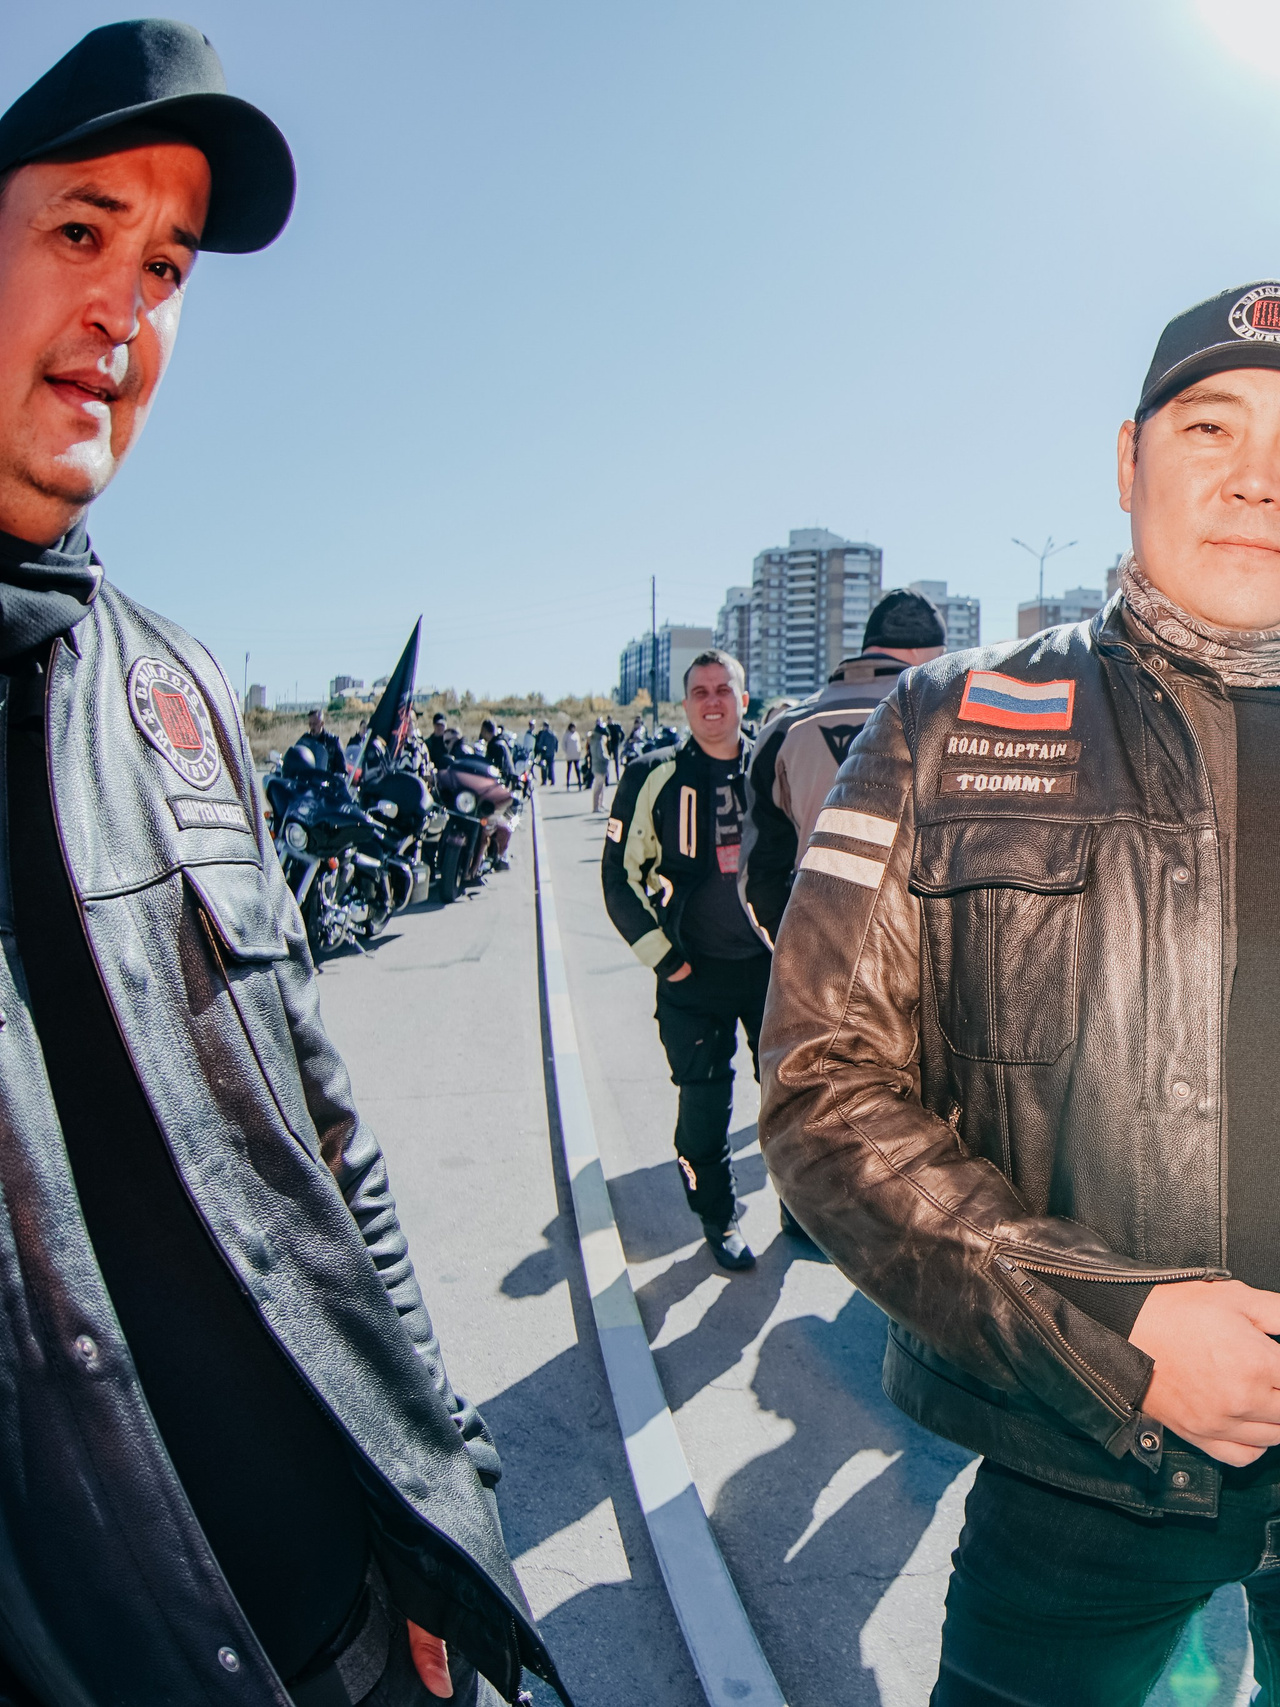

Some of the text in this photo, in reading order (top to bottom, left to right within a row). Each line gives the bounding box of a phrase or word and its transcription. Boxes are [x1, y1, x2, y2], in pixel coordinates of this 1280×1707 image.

[155, 729, 217, 780] MONGOLIA
[947, 736, 1068, 760] ROAD CAPTAIN
[956, 773, 1057, 794] TOOMMY
